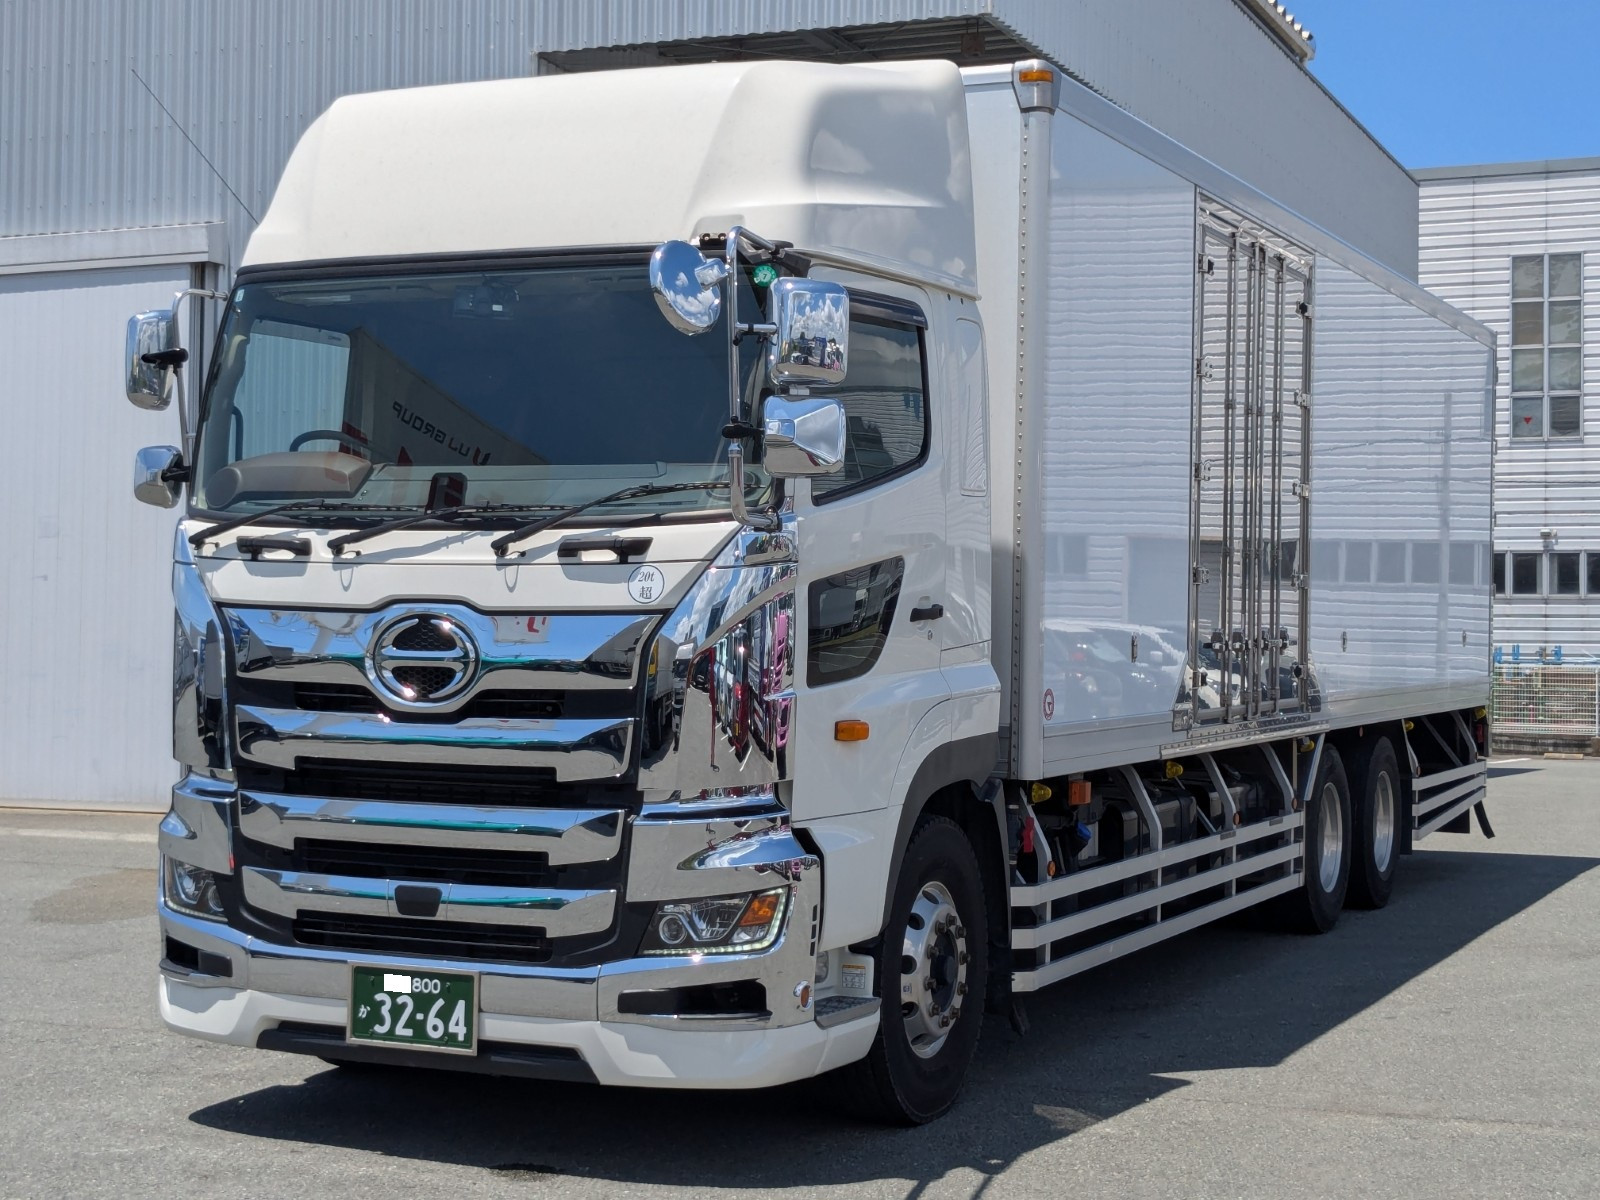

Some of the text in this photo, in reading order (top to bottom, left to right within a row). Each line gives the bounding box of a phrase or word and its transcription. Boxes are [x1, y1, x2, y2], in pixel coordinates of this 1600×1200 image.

[638, 571, 655, 582] 20t
[639, 586, 653, 599] 超
[412, 977, 441, 994] 800
[358, 992, 467, 1042] か 32-64
